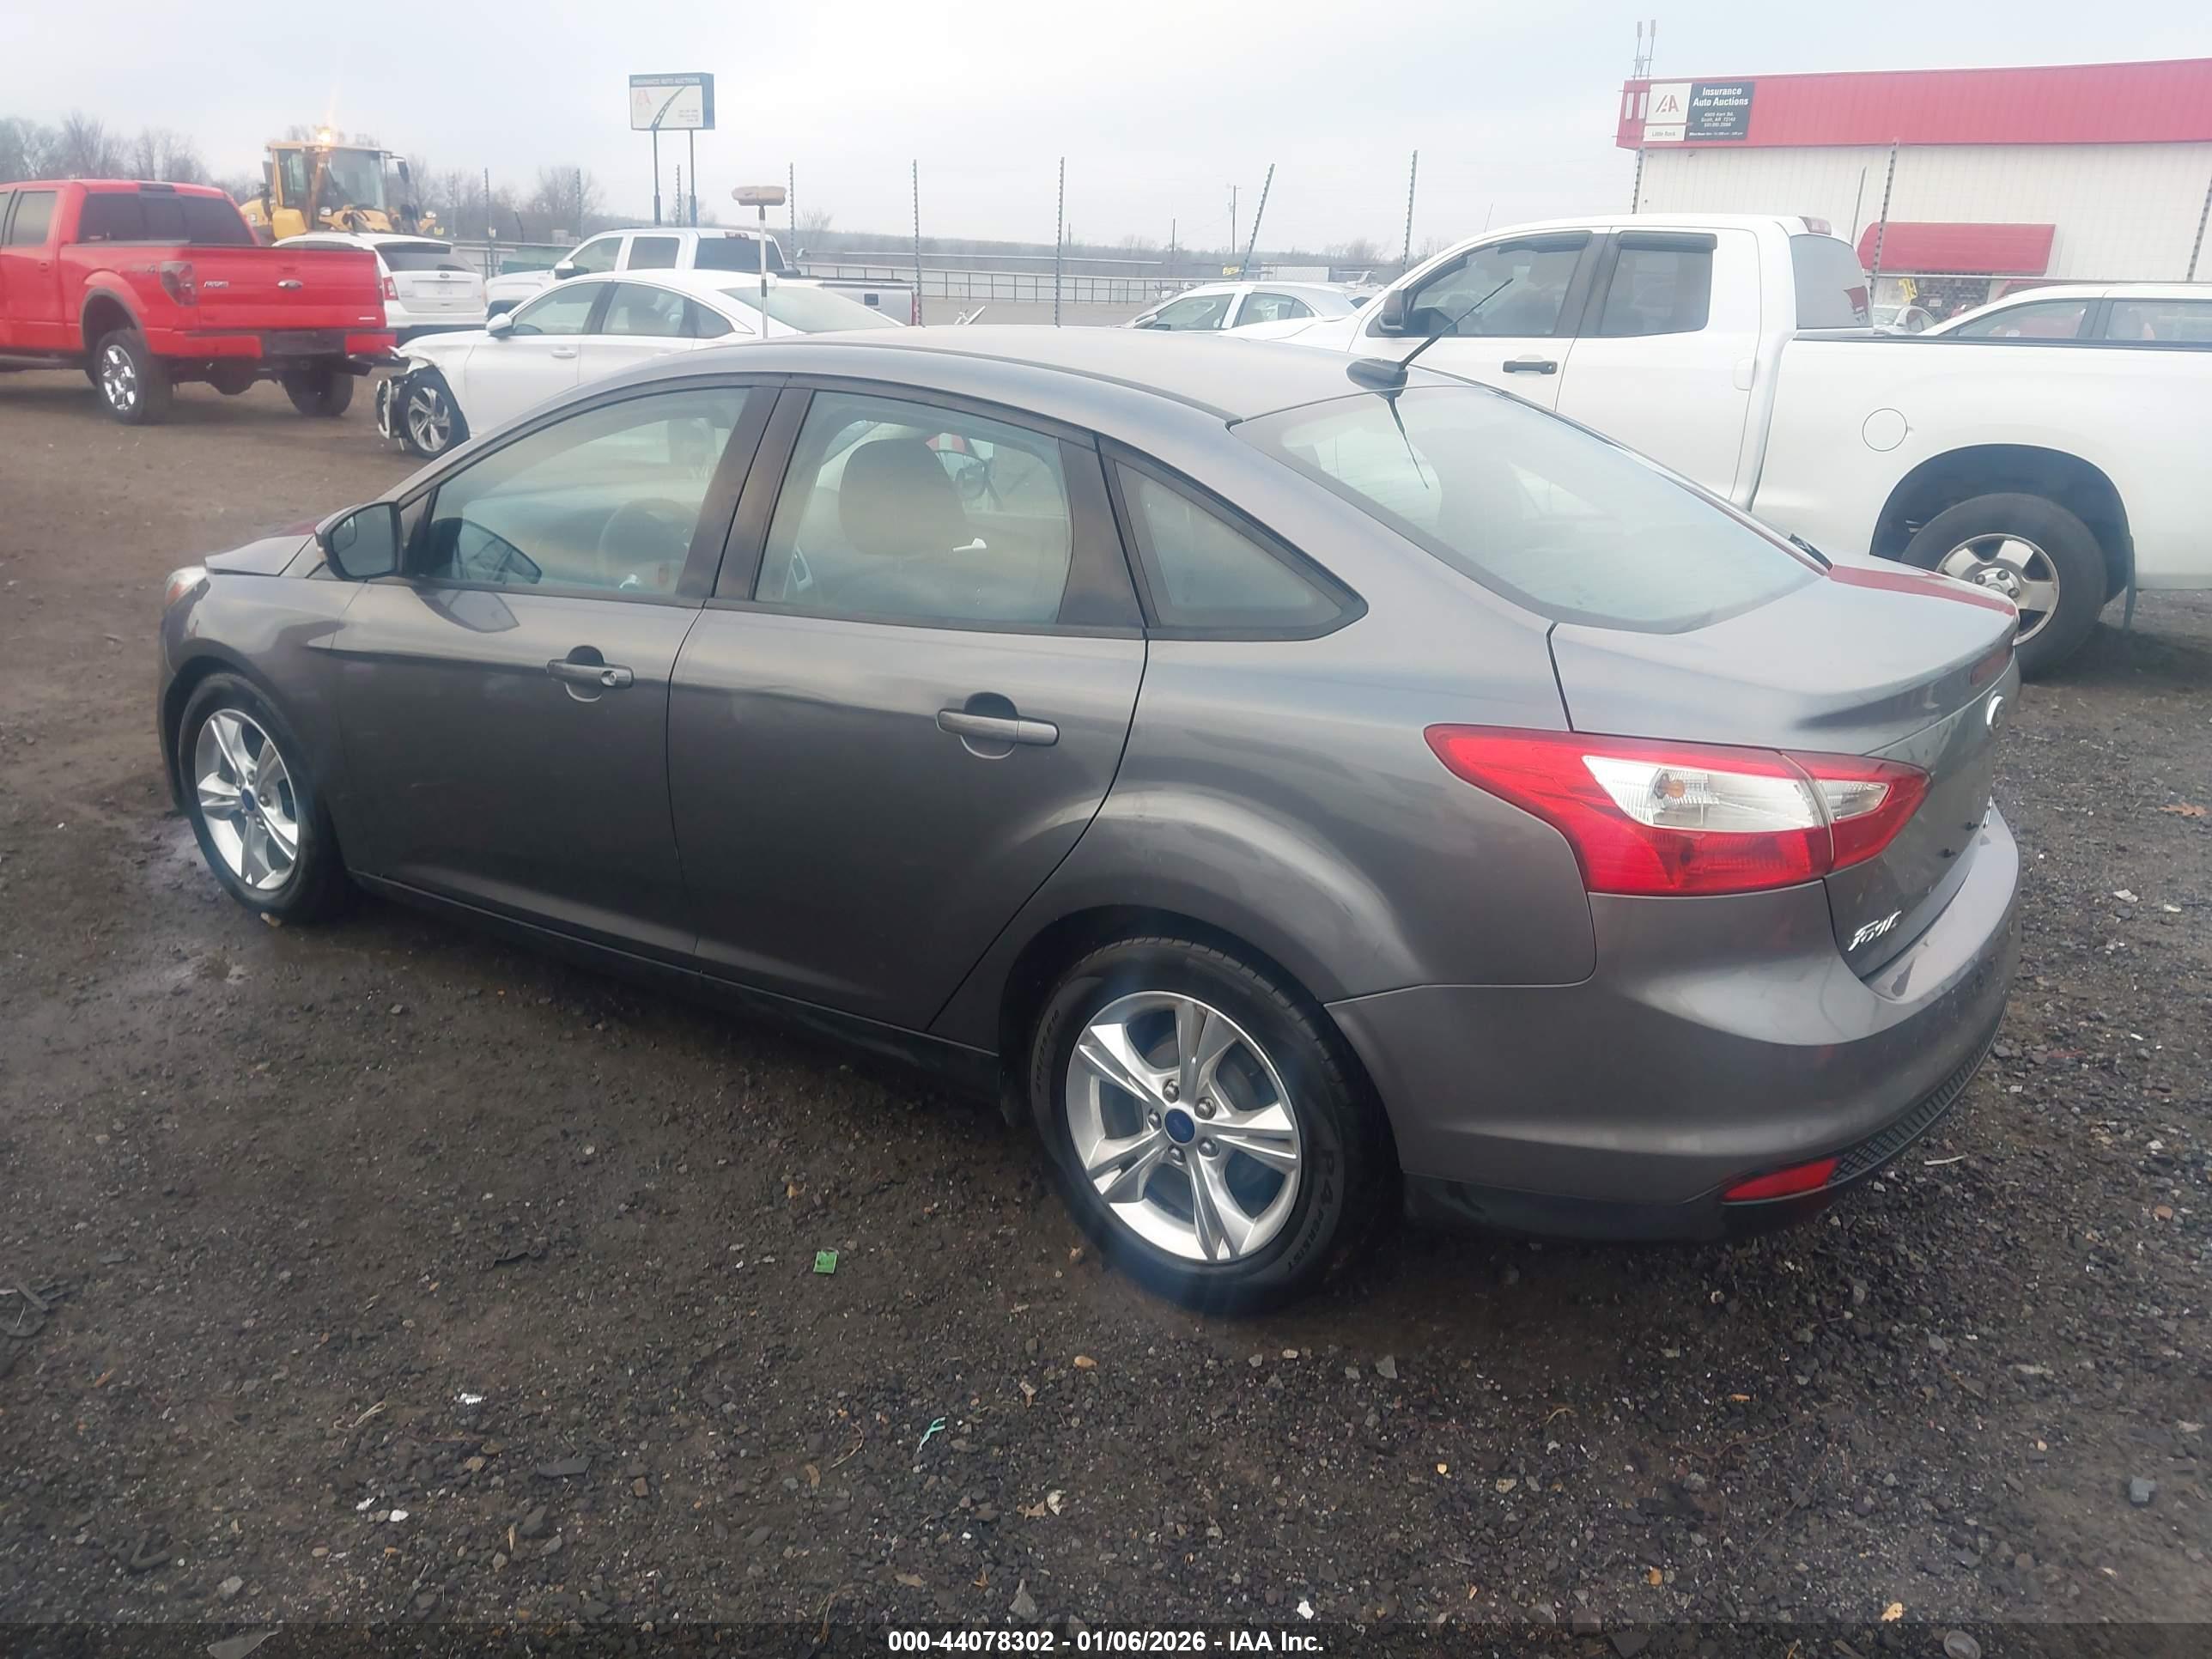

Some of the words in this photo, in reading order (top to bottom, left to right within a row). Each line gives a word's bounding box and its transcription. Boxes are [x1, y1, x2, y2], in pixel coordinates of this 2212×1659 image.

[1702, 87, 1742, 96] Insurance
[1692, 97, 1711, 106] Auto
[1712, 96, 1749, 106] Auctions
